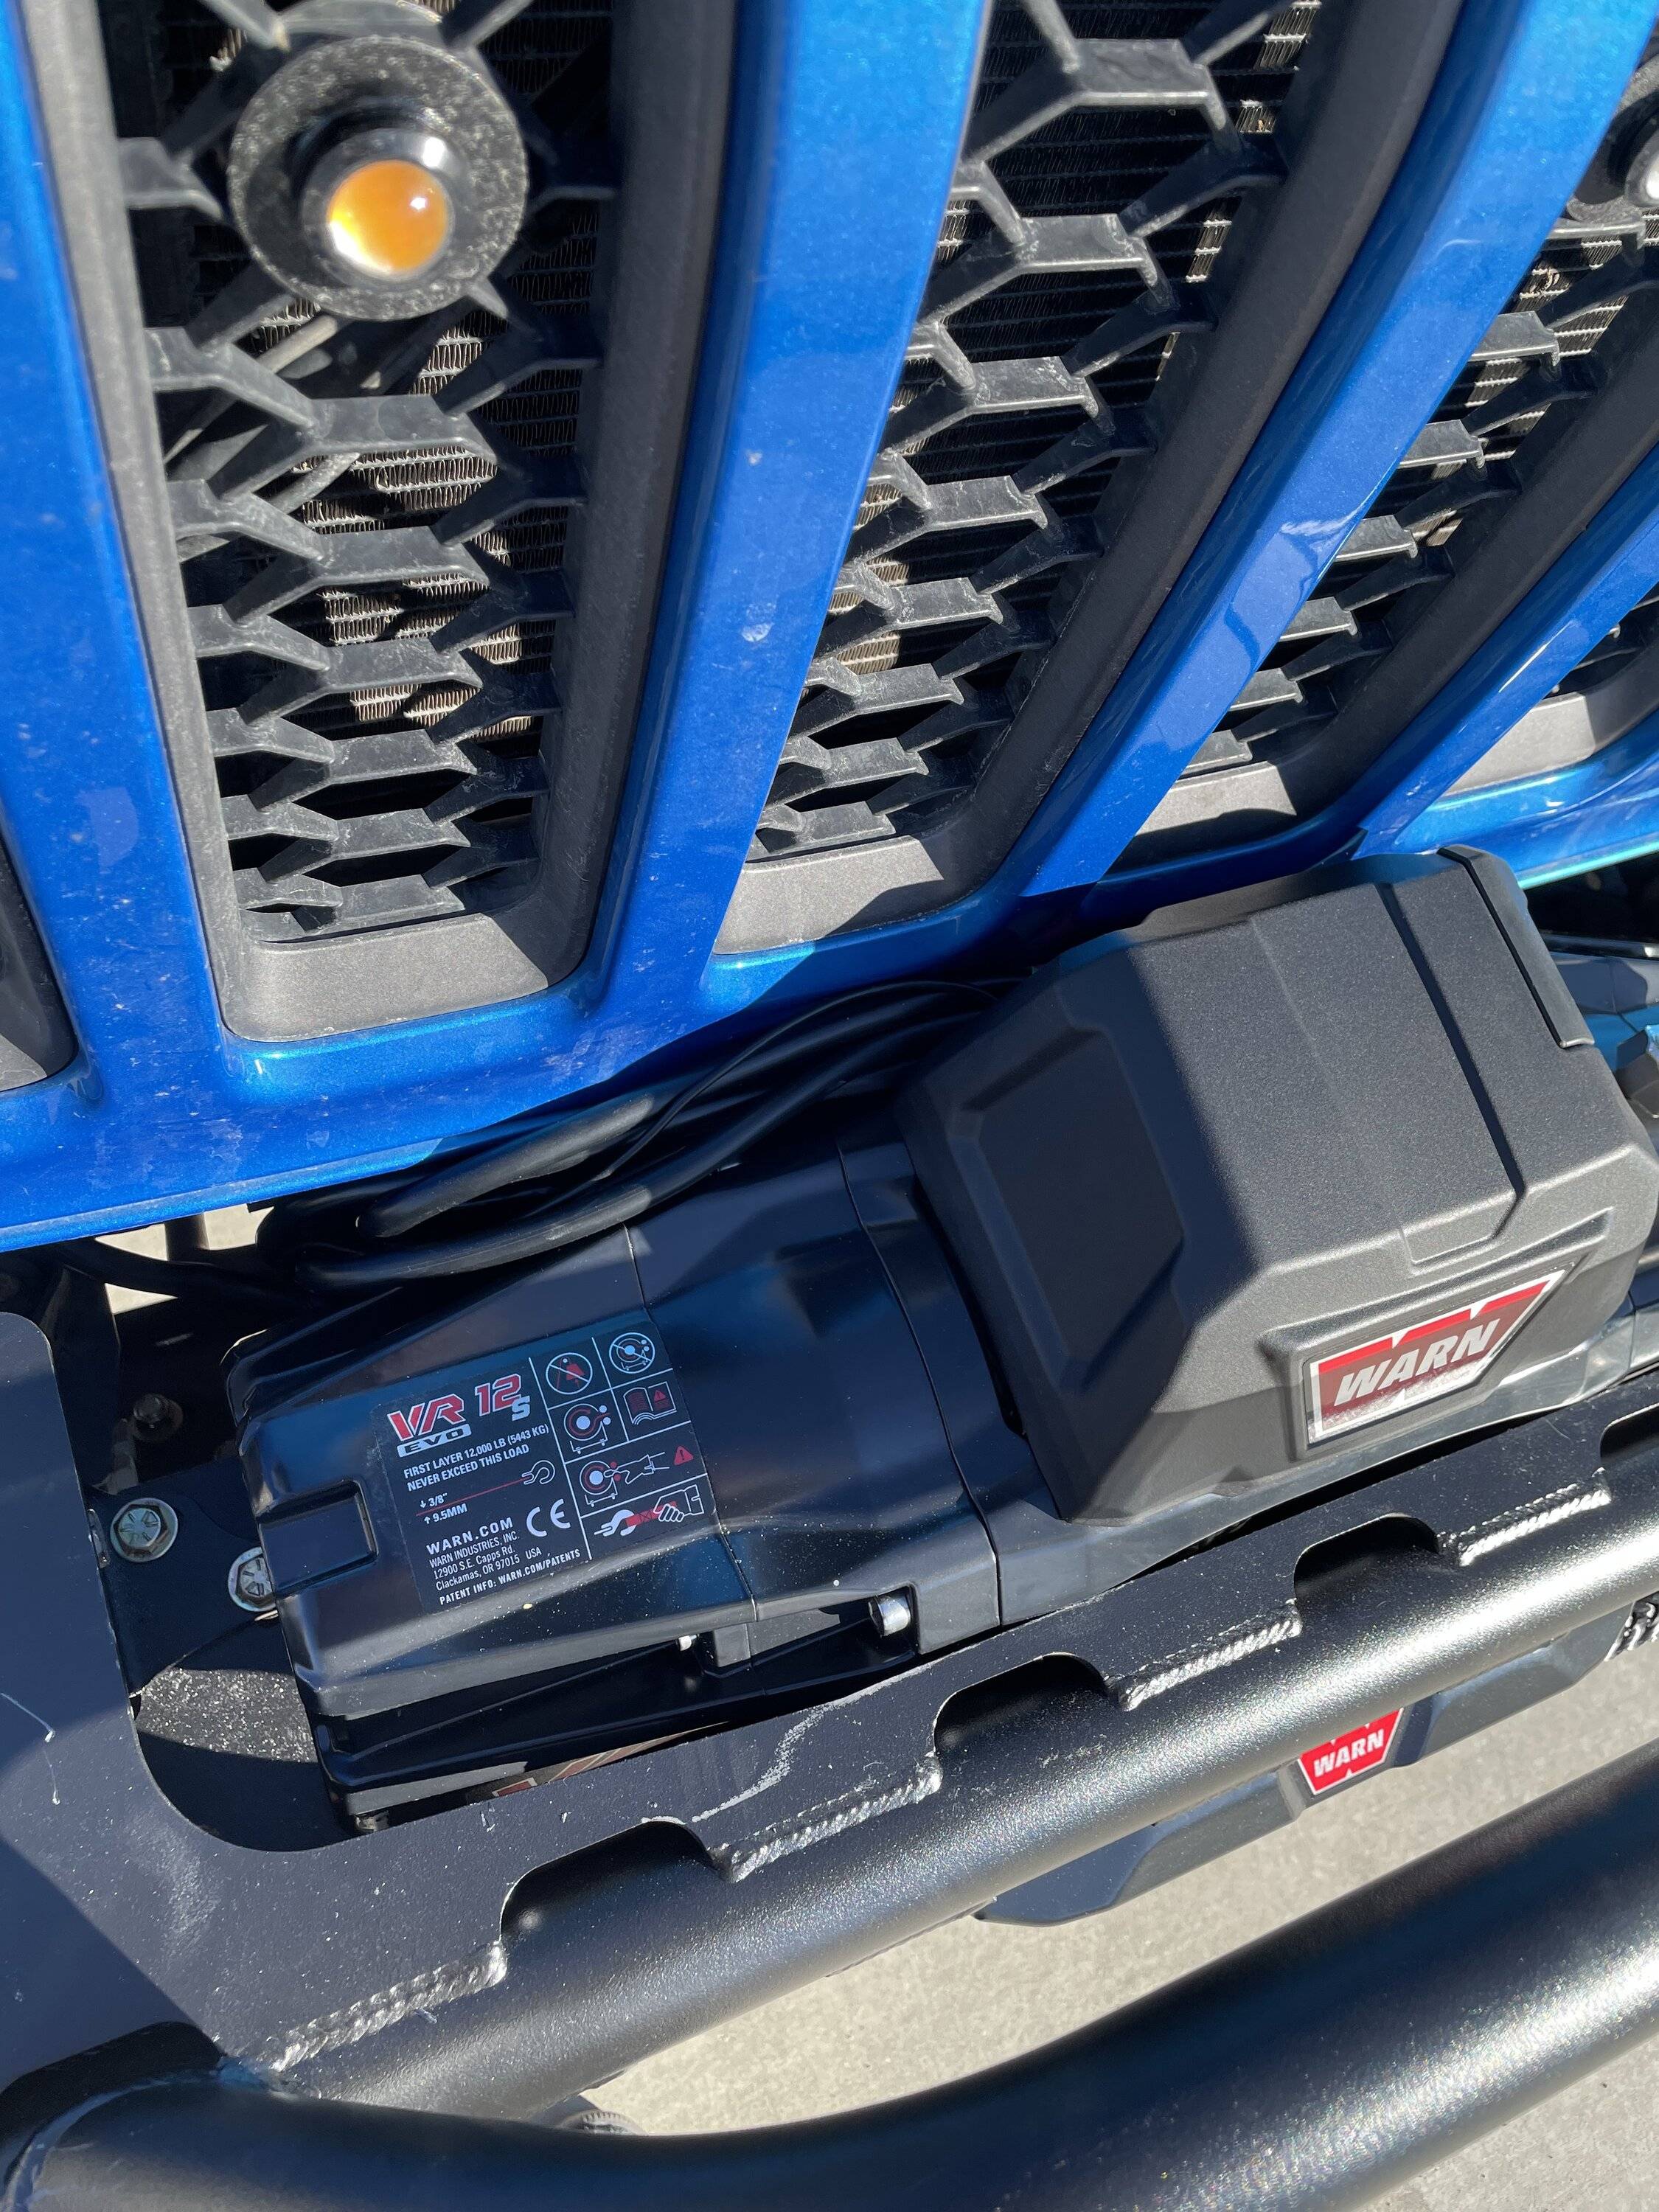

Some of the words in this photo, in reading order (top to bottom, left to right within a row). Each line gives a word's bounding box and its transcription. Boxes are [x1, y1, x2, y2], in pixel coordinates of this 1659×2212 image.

[1334, 1318, 1501, 1407] WARN
[387, 1394, 466, 1441] VR
[403, 1427, 465, 1455] EVO
[403, 1461, 431, 1478] FIRST
[433, 1452, 464, 1469] LAYER
[464, 1442, 493, 1458] 12,000
[495, 1438, 506, 1450] LB
[507, 1429, 532, 1446] (5443
[532, 1424, 549, 1437] KG)
[407, 1475, 441, 1492] NEVER
[442, 1461, 479, 1481] EXCEED
[479, 1453, 502, 1468] THIS
[504, 1444, 529, 1460] LOAD
[433, 1503, 467, 1523] 9.5MM
[526, 1498, 571, 1537] CE
[426, 1517, 513, 1555] WARN.COM
[429, 1553, 453, 1568] WARN
[503, 1531, 520, 1543] INC.
[434, 1565, 459, 1579] 12900
[460, 1560, 475, 1571] S.E.
[476, 1550, 501, 1568] Capps
[502, 1545, 515, 1557] Rd.
[436, 1571, 481, 1591] Clackamas,
[482, 1563, 495, 1573] OR
[496, 1554, 520, 1570] 97015
[526, 1547, 542, 1559] USA
[439, 1587, 470, 1605] PATENT
[473, 1579, 497, 1594] INFO:
[498, 1548, 581, 1585] WARN.COM/PATENTS
[1312, 1728, 1385, 1778] WARN
